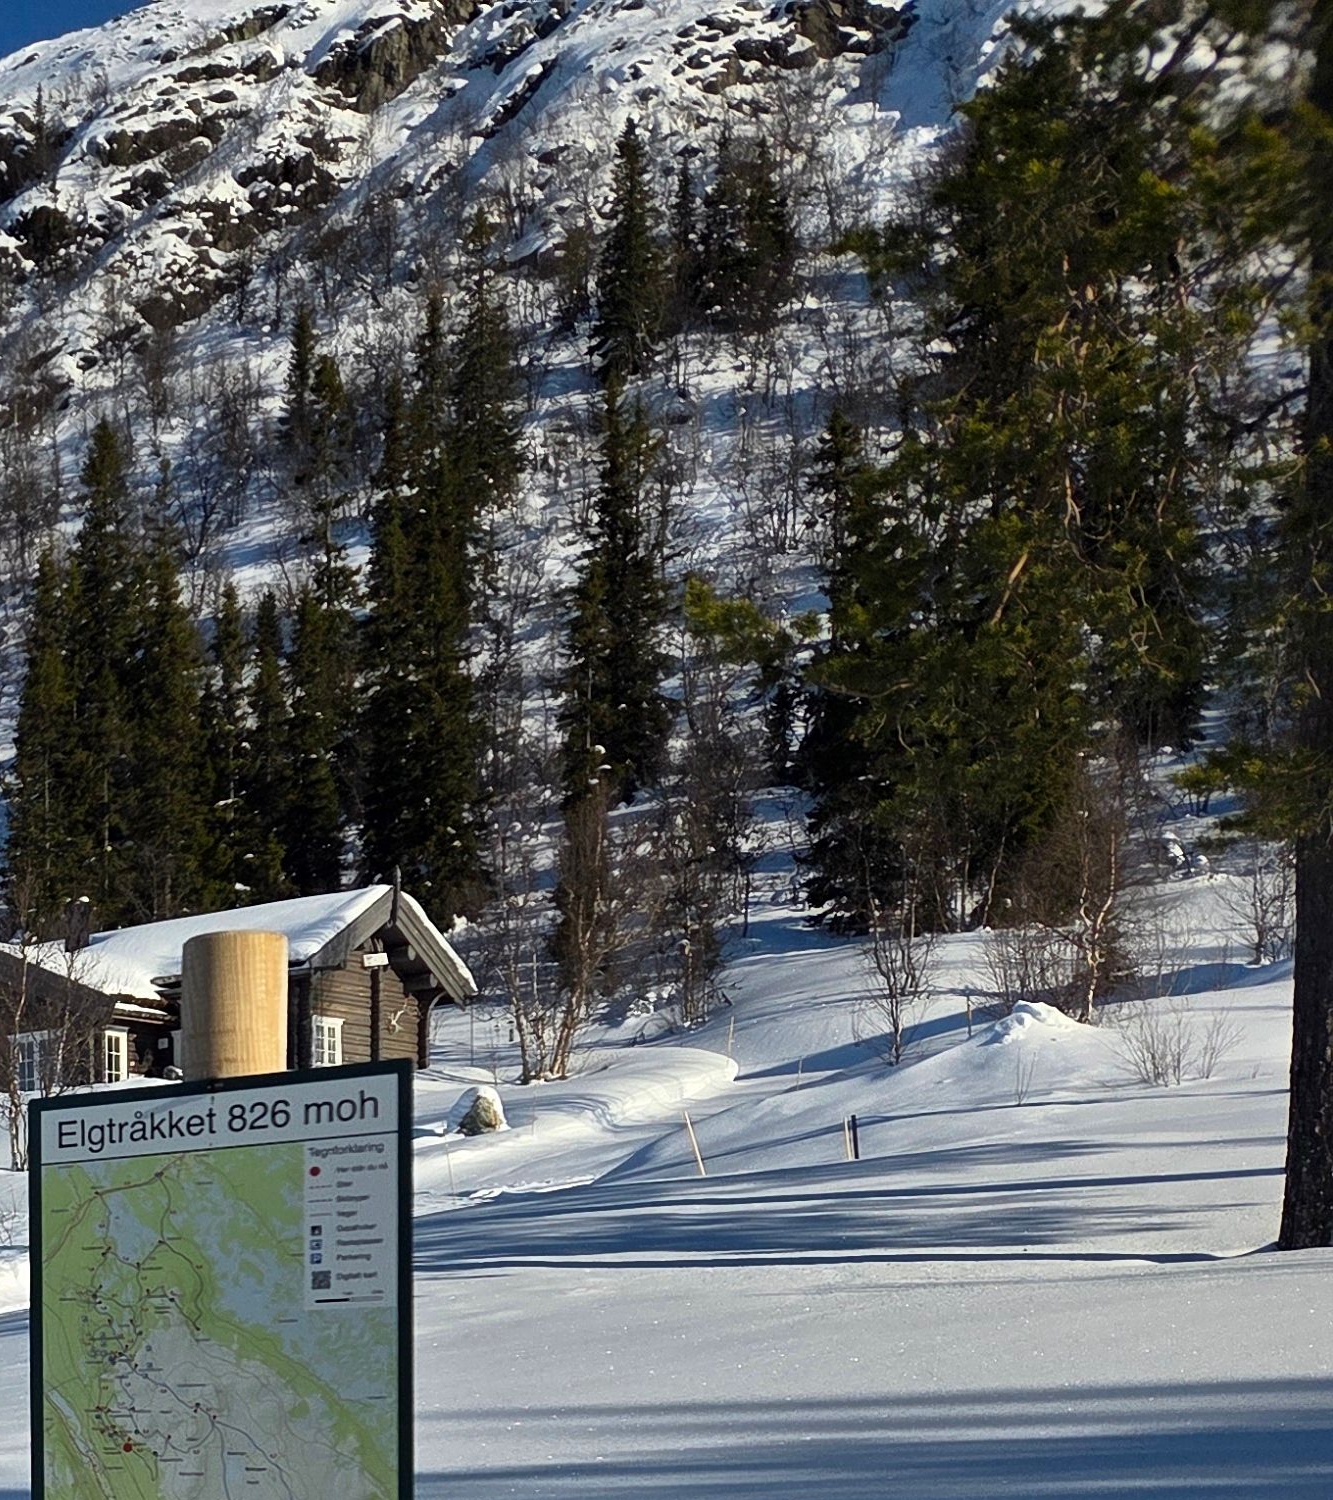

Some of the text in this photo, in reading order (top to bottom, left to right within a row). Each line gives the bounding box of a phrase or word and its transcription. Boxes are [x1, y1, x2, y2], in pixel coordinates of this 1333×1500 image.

[58, 1090, 379, 1153] Elgtråkket 826 moh
